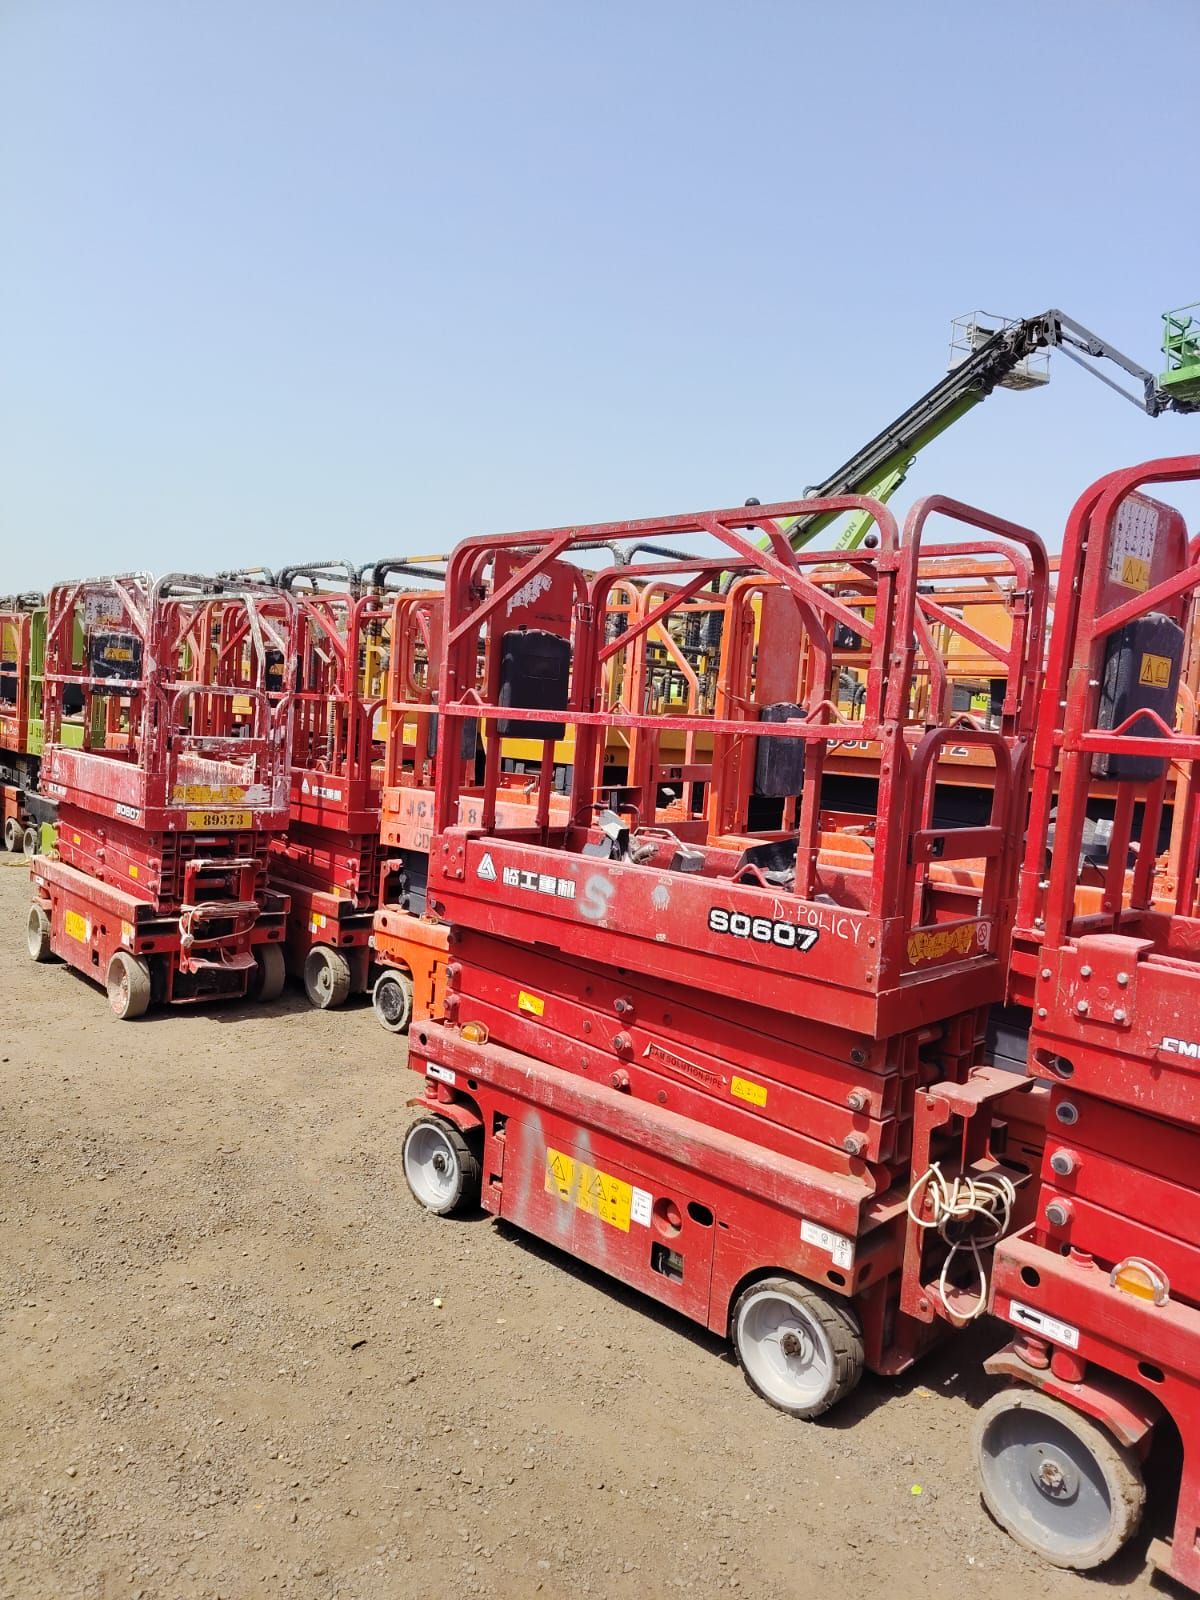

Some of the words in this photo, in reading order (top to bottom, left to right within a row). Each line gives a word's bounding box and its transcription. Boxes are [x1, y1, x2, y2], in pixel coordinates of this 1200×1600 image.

[203, 814, 244, 826] 89373
[666, 1056, 704, 1080] SOLUTION
[705, 1074, 722, 1089] PIPE
